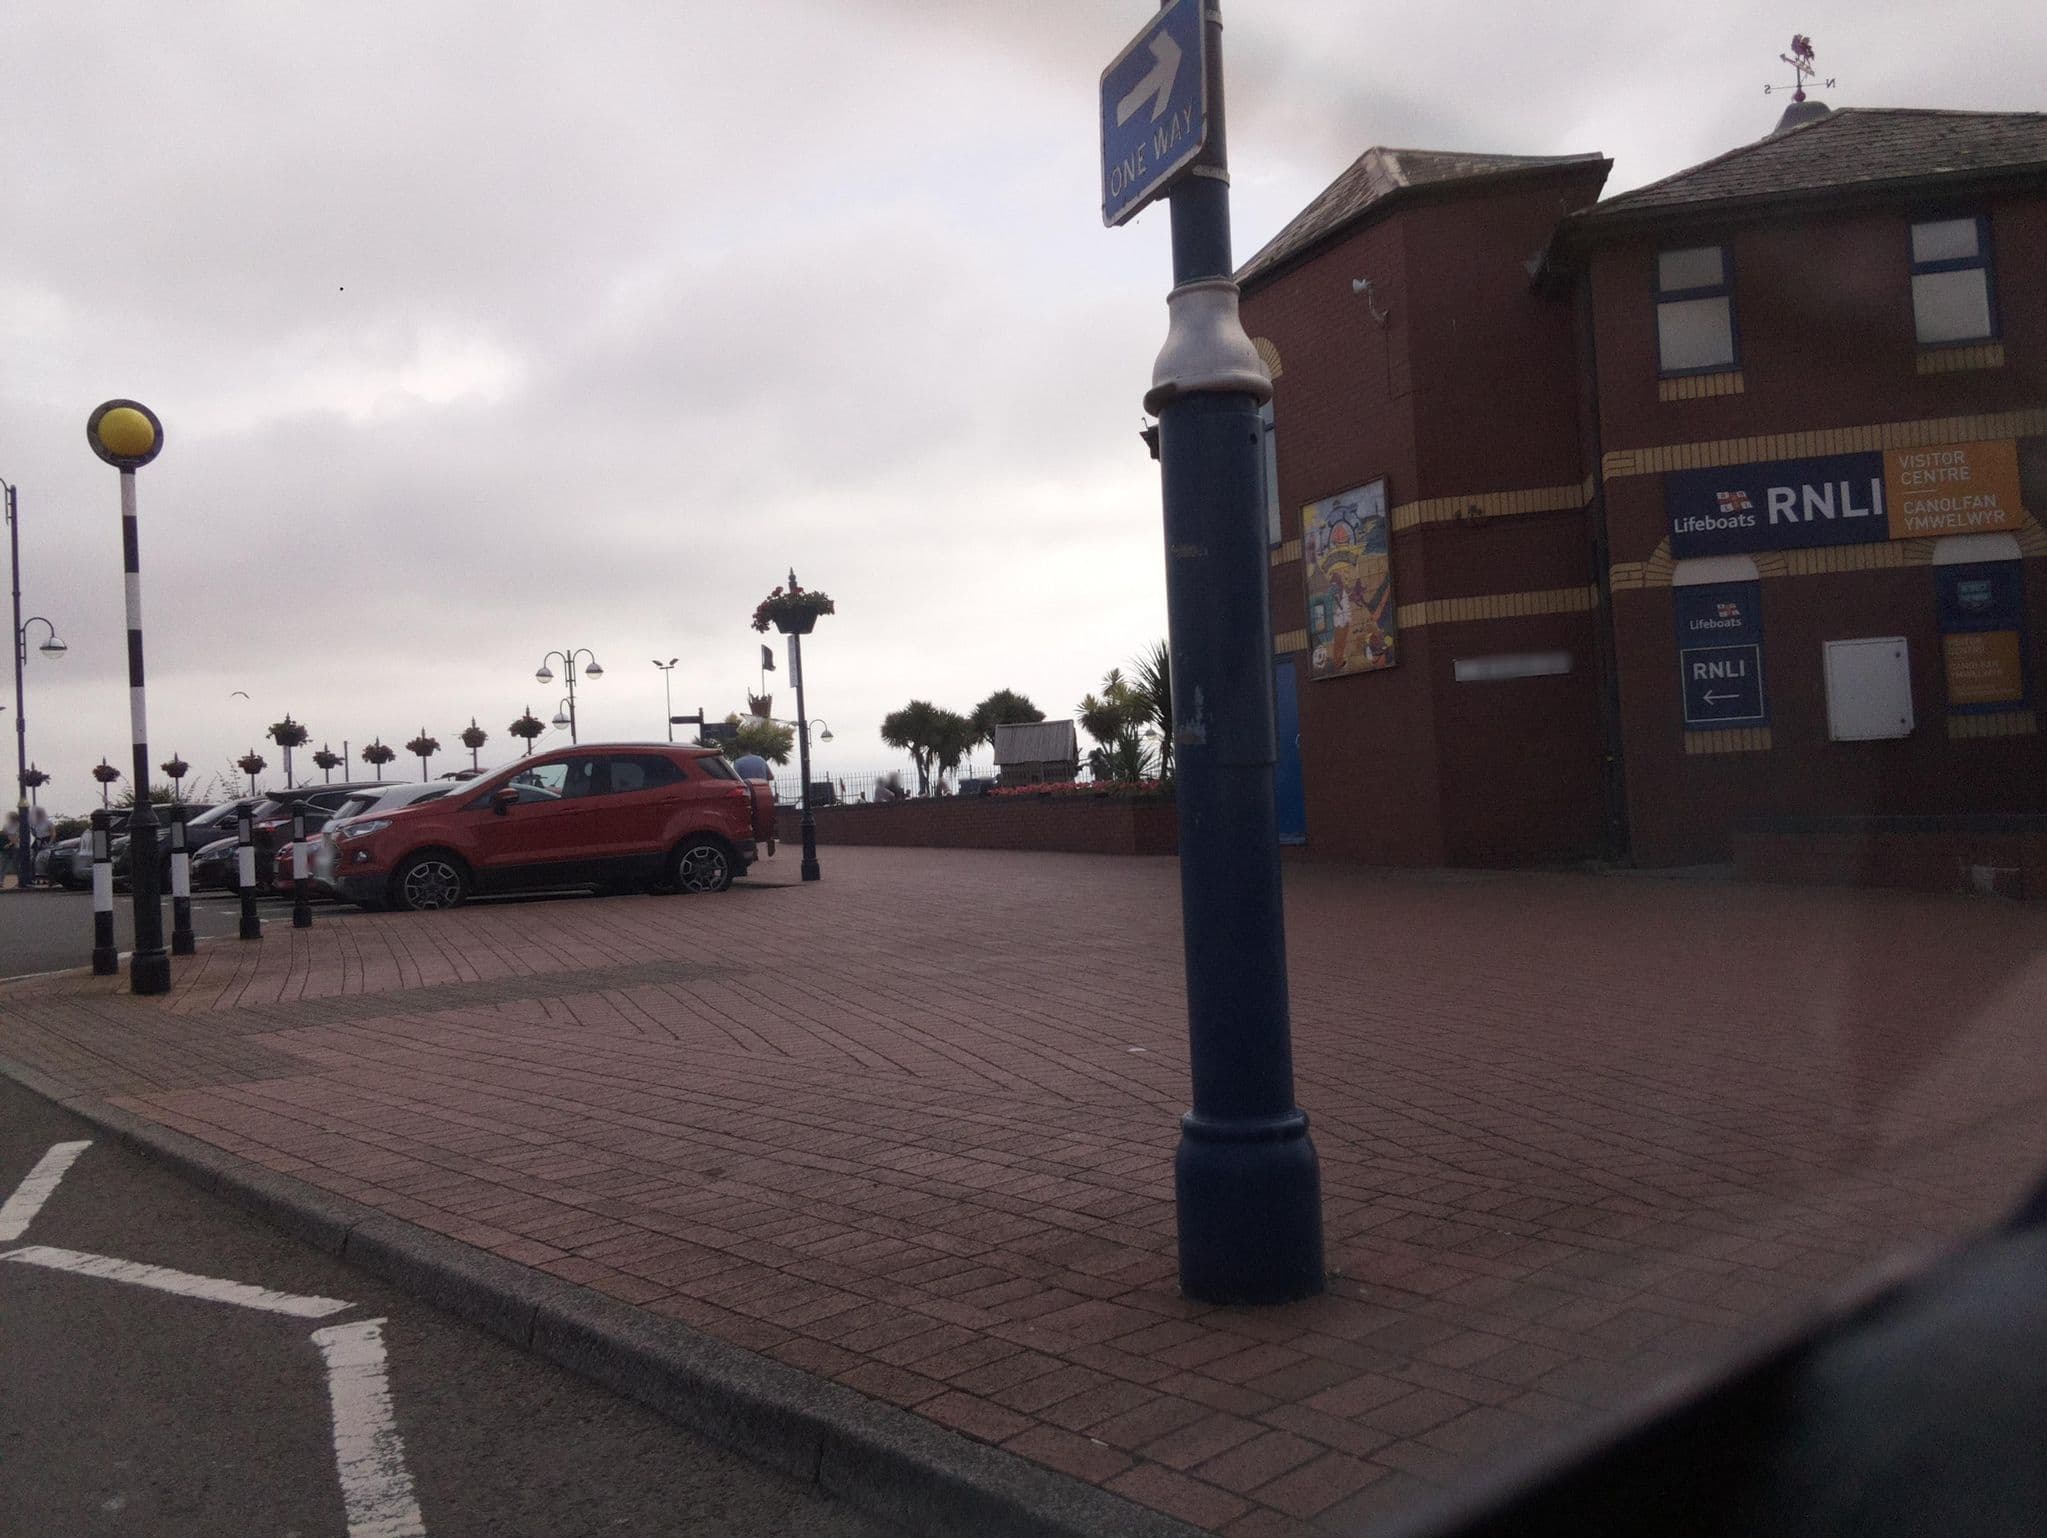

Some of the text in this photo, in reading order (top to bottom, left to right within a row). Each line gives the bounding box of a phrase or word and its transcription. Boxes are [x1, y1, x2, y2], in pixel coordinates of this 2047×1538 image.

[1111, 99, 1193, 198] ONE WAY
[1899, 450, 1966, 469] VISITOR
[1901, 466, 1970, 485] CENTRE
[1674, 513, 1756, 533] Lifeboats
[1767, 478, 1883, 524] RNLI
[1903, 494, 1997, 514] CANOLFAN
[1904, 510, 2006, 531] YMWELWYR
[1689, 618, 1742, 630] Lifeboats
[1693, 660, 1745, 680] RNLI
